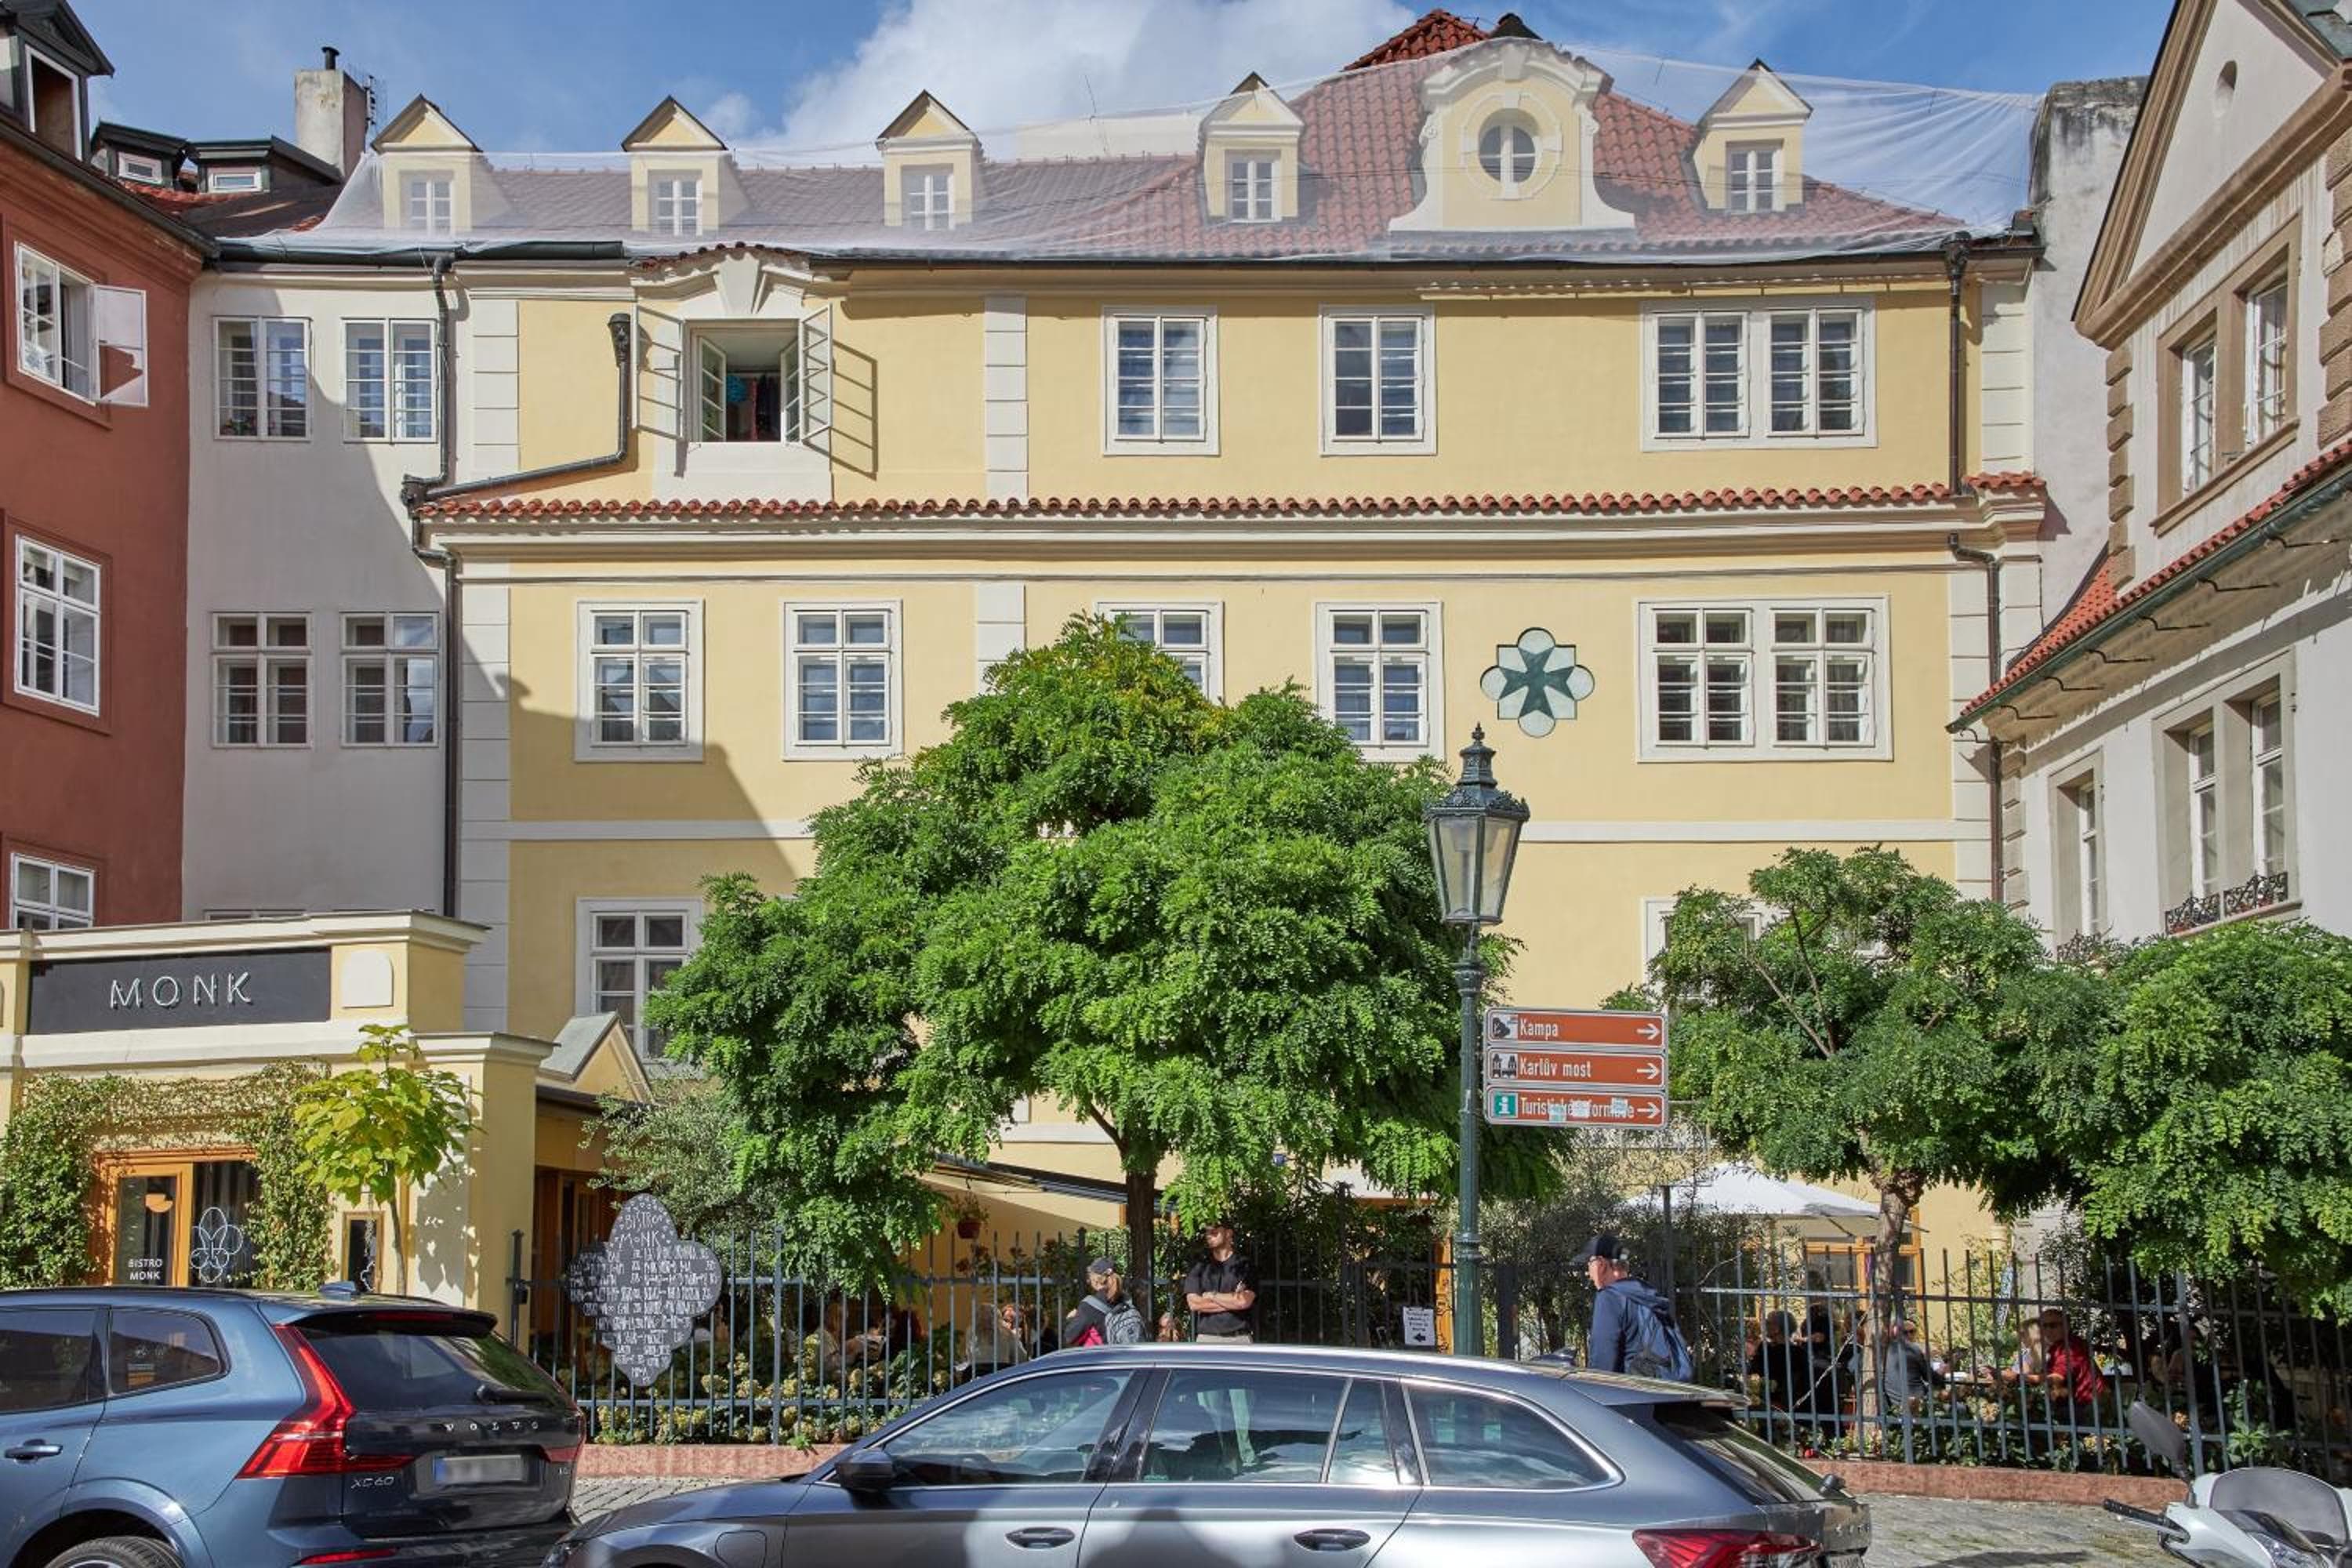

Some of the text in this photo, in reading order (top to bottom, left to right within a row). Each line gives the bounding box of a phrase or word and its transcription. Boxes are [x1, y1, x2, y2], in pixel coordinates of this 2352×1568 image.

[110, 971, 252, 1010] MONK
[1519, 1018, 1559, 1040] Kampa
[1519, 1058, 1592, 1078] Karlův most
[128, 1258, 163, 1268] BISTRO
[129, 1271, 161, 1280] MONK
[445, 1421, 539, 1432] VOLVO
[350, 1476, 394, 1489] XC60
